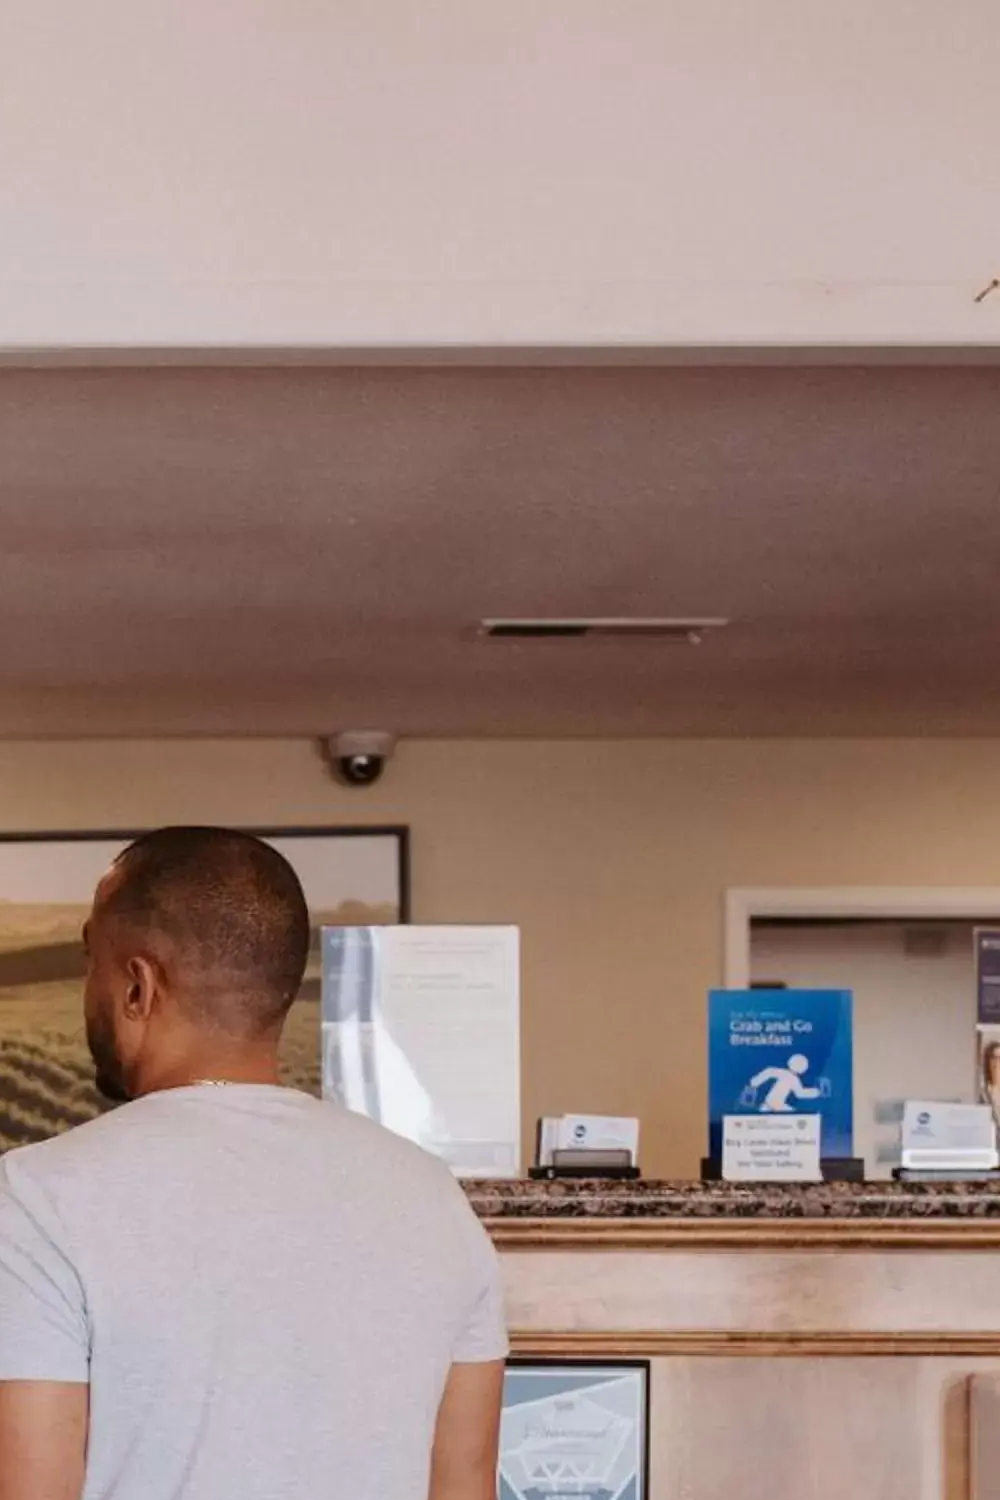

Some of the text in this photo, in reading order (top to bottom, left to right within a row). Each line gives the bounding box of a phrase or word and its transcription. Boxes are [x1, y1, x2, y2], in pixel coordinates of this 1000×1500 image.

[730, 1019, 812, 1033] Grab and Go
[730, 1033, 793, 1046] Breakfast
